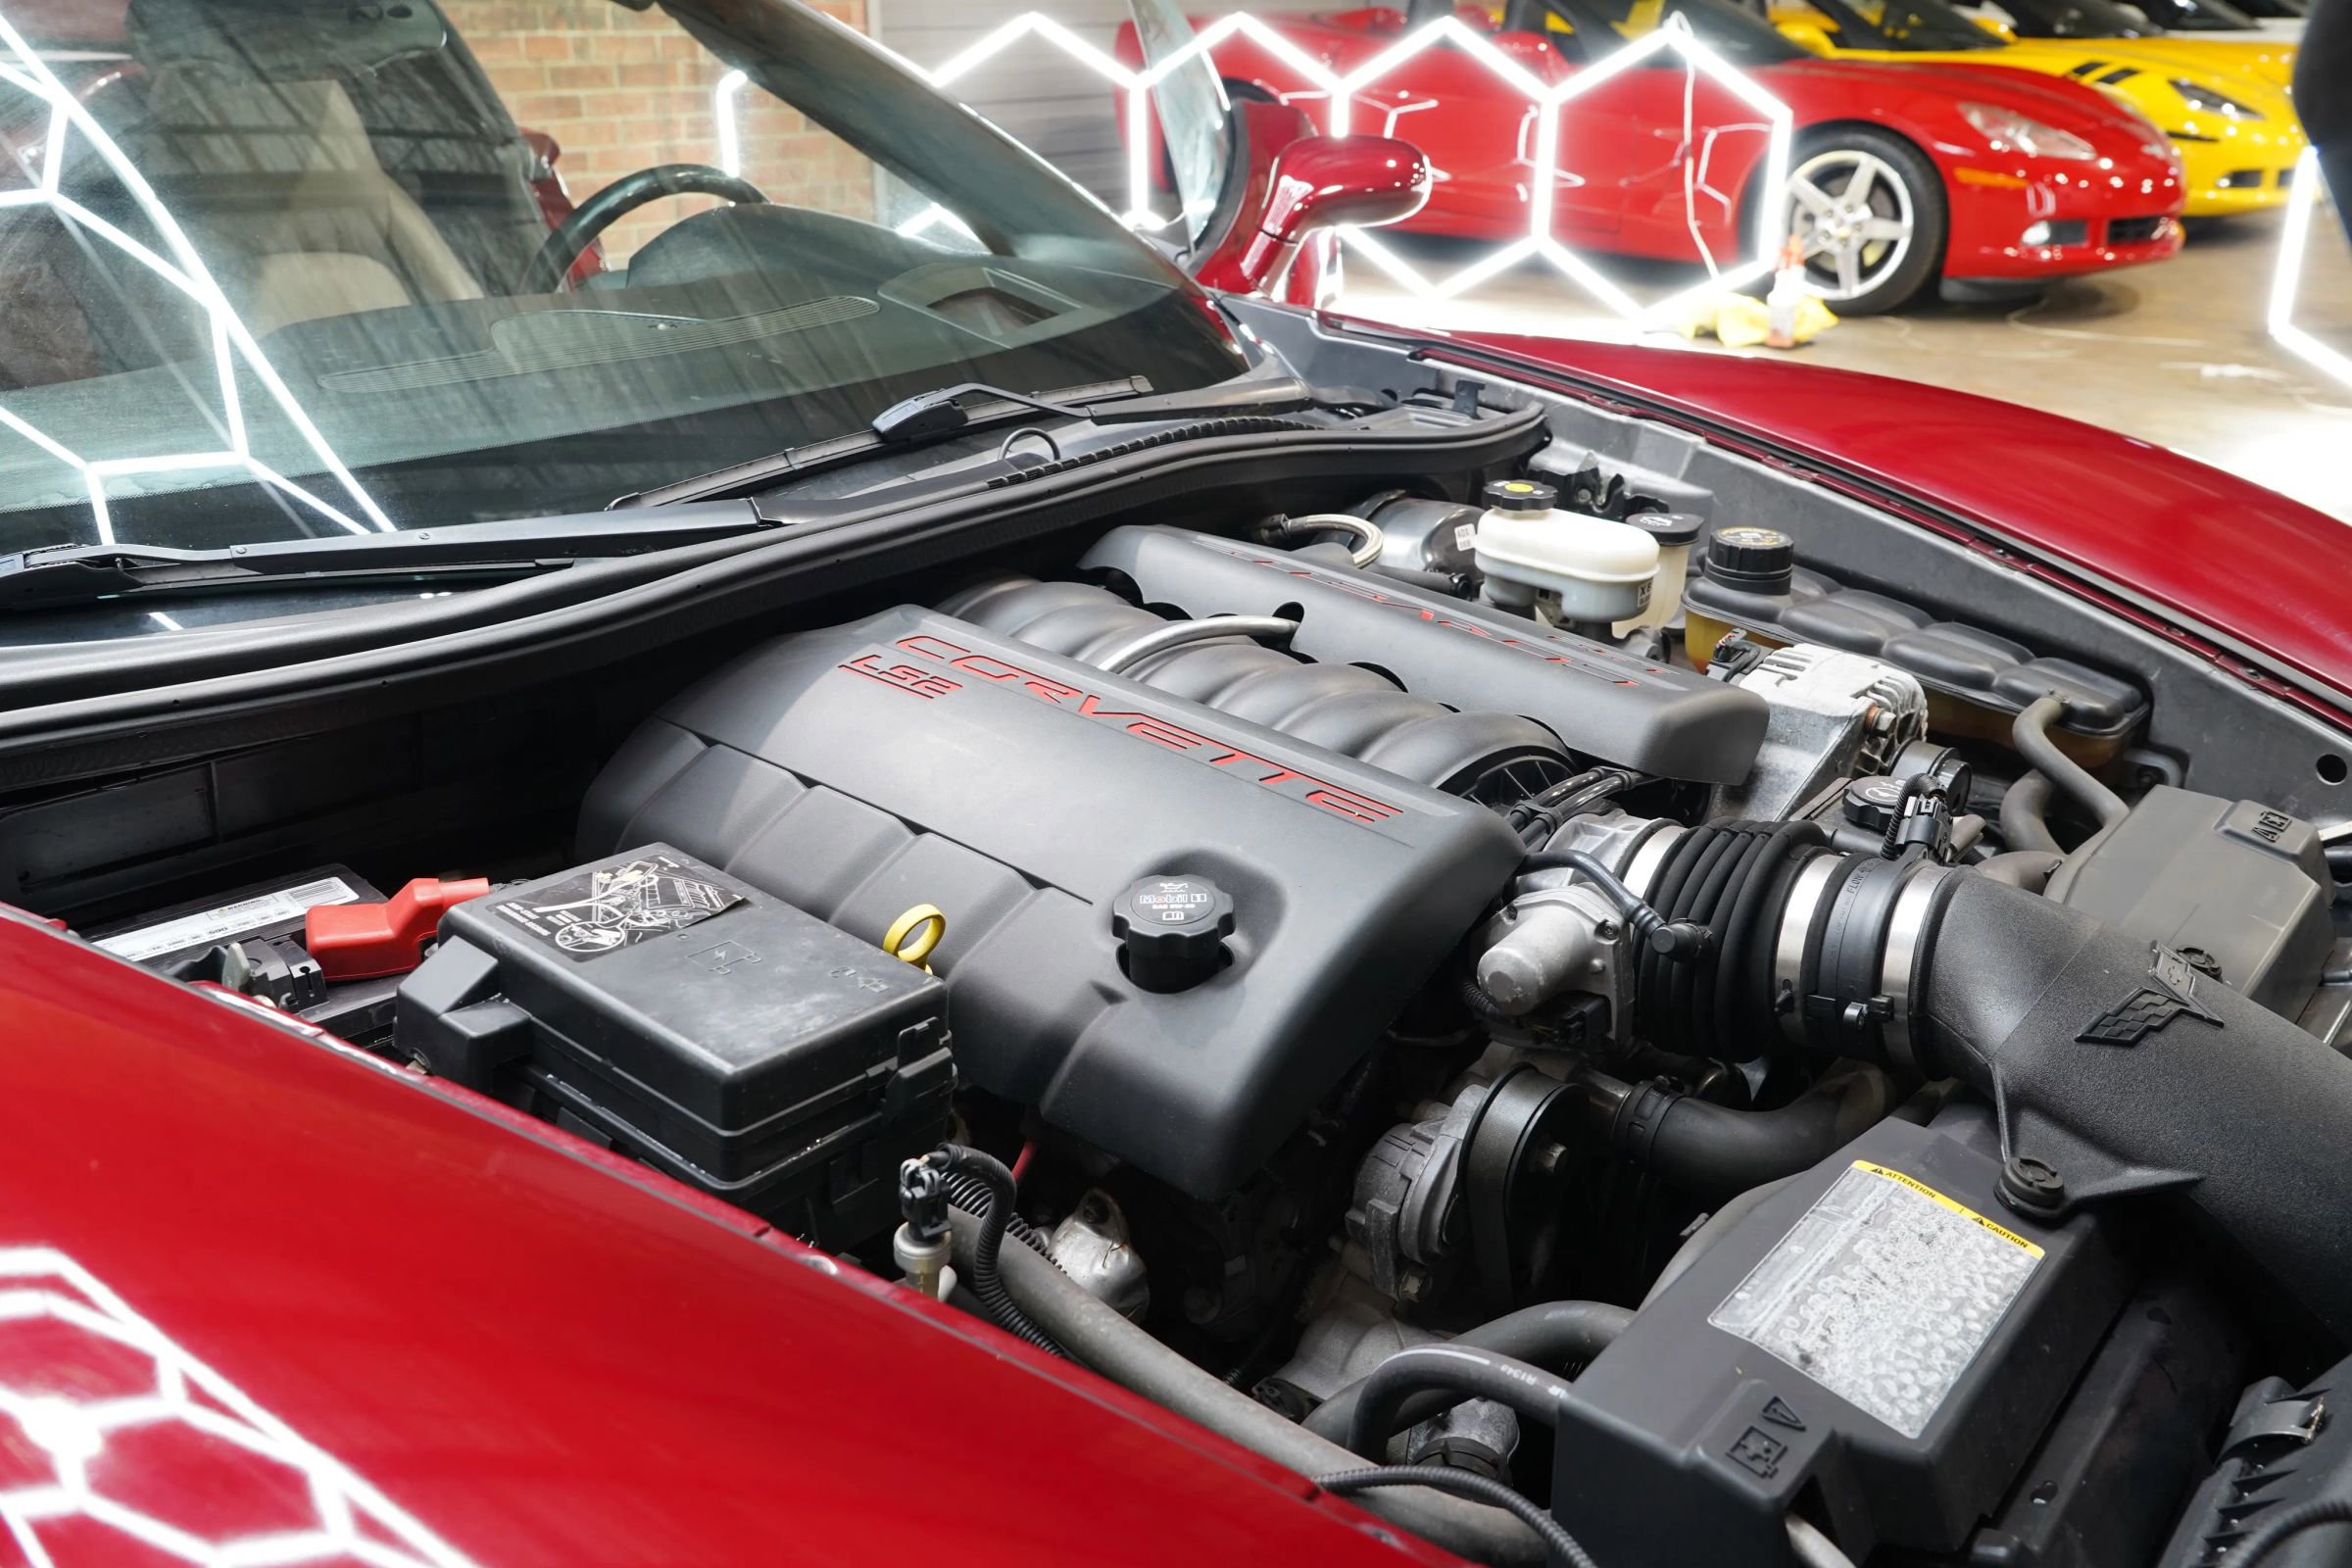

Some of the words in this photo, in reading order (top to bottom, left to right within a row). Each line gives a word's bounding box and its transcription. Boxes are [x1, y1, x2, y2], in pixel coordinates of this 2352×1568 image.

[847, 654, 964, 698] LS2
[895, 635, 1404, 824] CORVETTE
[1139, 893, 1188, 904] Mobil
[1885, 1171, 1936, 1200] ATTENTION
[1985, 1222, 2030, 1250] CAUTION
